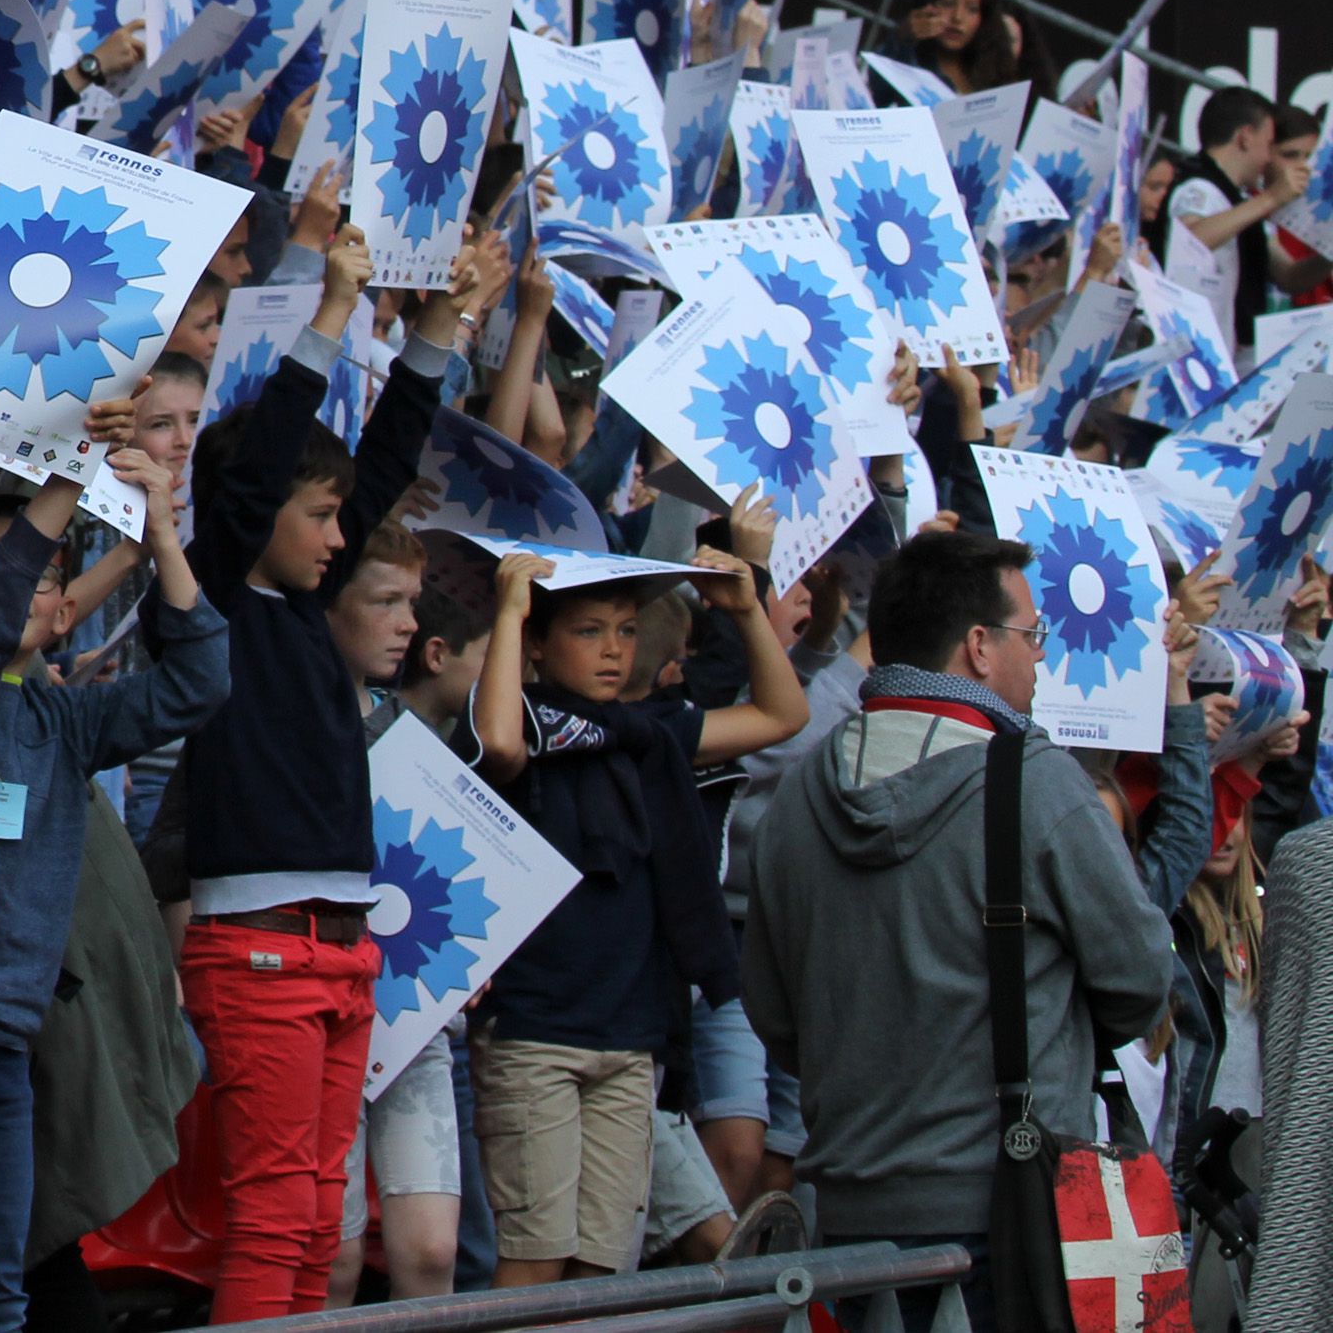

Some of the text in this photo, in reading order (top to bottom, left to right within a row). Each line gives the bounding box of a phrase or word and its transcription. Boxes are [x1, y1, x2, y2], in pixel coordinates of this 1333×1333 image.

[845, 116, 880, 126] rennes
[100, 151, 163, 176] rennes
[665, 299, 703, 334] rennes
[1058, 727, 1097, 739] rennes
[470, 785, 517, 832] rennes
